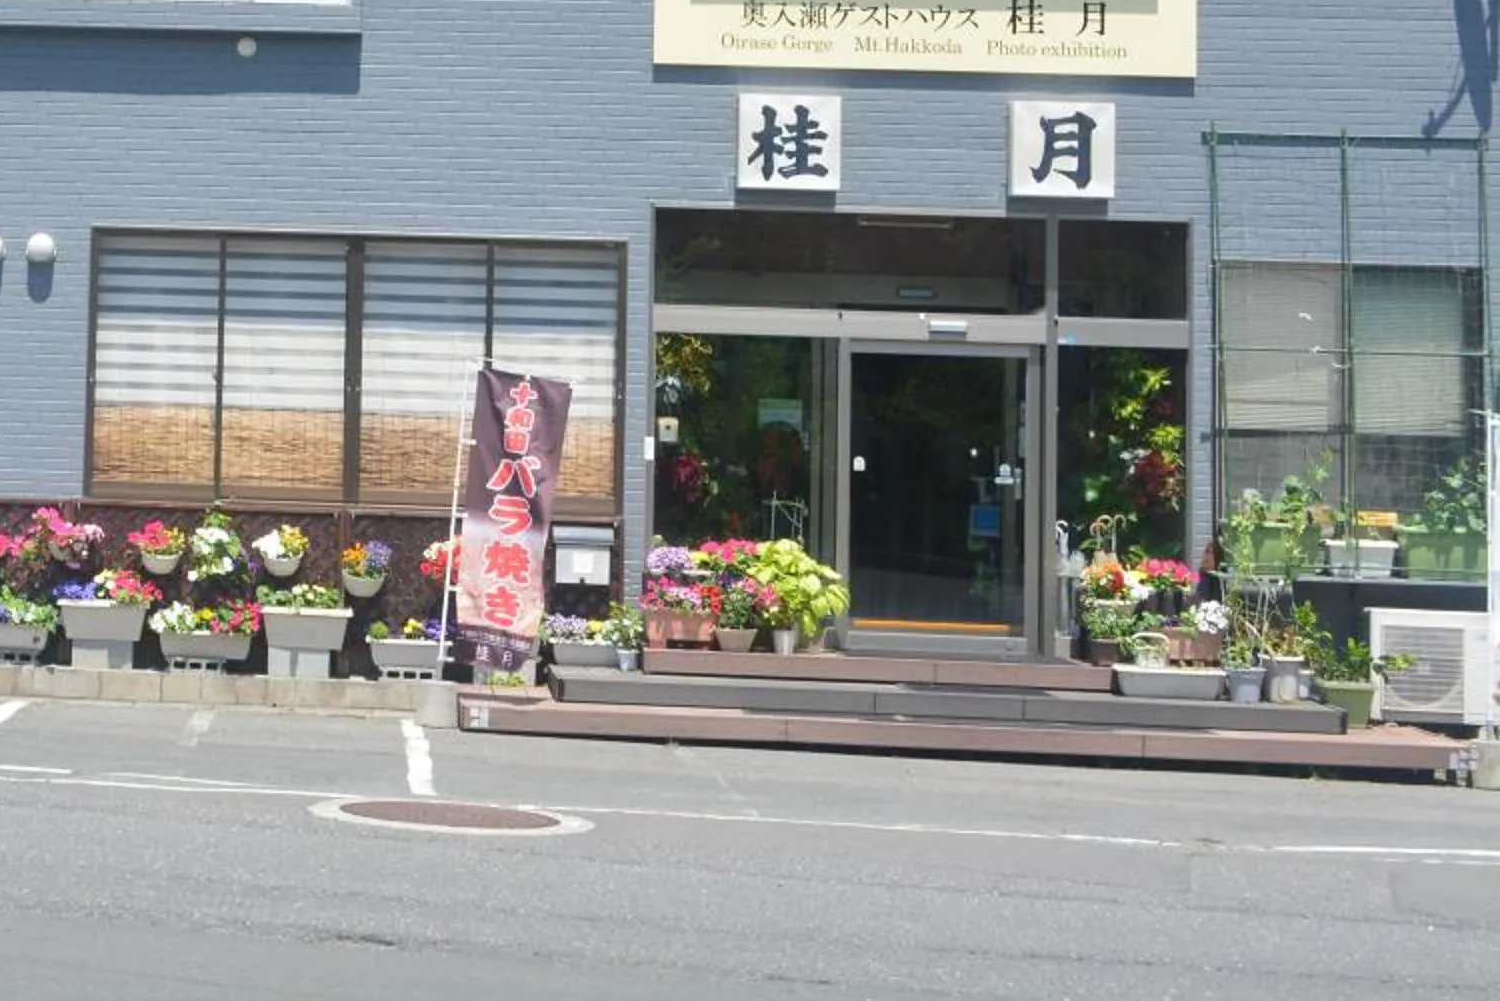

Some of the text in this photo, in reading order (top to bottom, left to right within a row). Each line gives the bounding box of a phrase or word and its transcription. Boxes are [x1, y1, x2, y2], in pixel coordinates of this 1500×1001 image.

[740, 0, 979, 32] 奥入瀬ゲストハウス
[721, 32, 834, 54] Oirase Gorge
[987, 40, 1128, 58] Photo exhibition
[747, 104, 1098, 190] 桂 月
